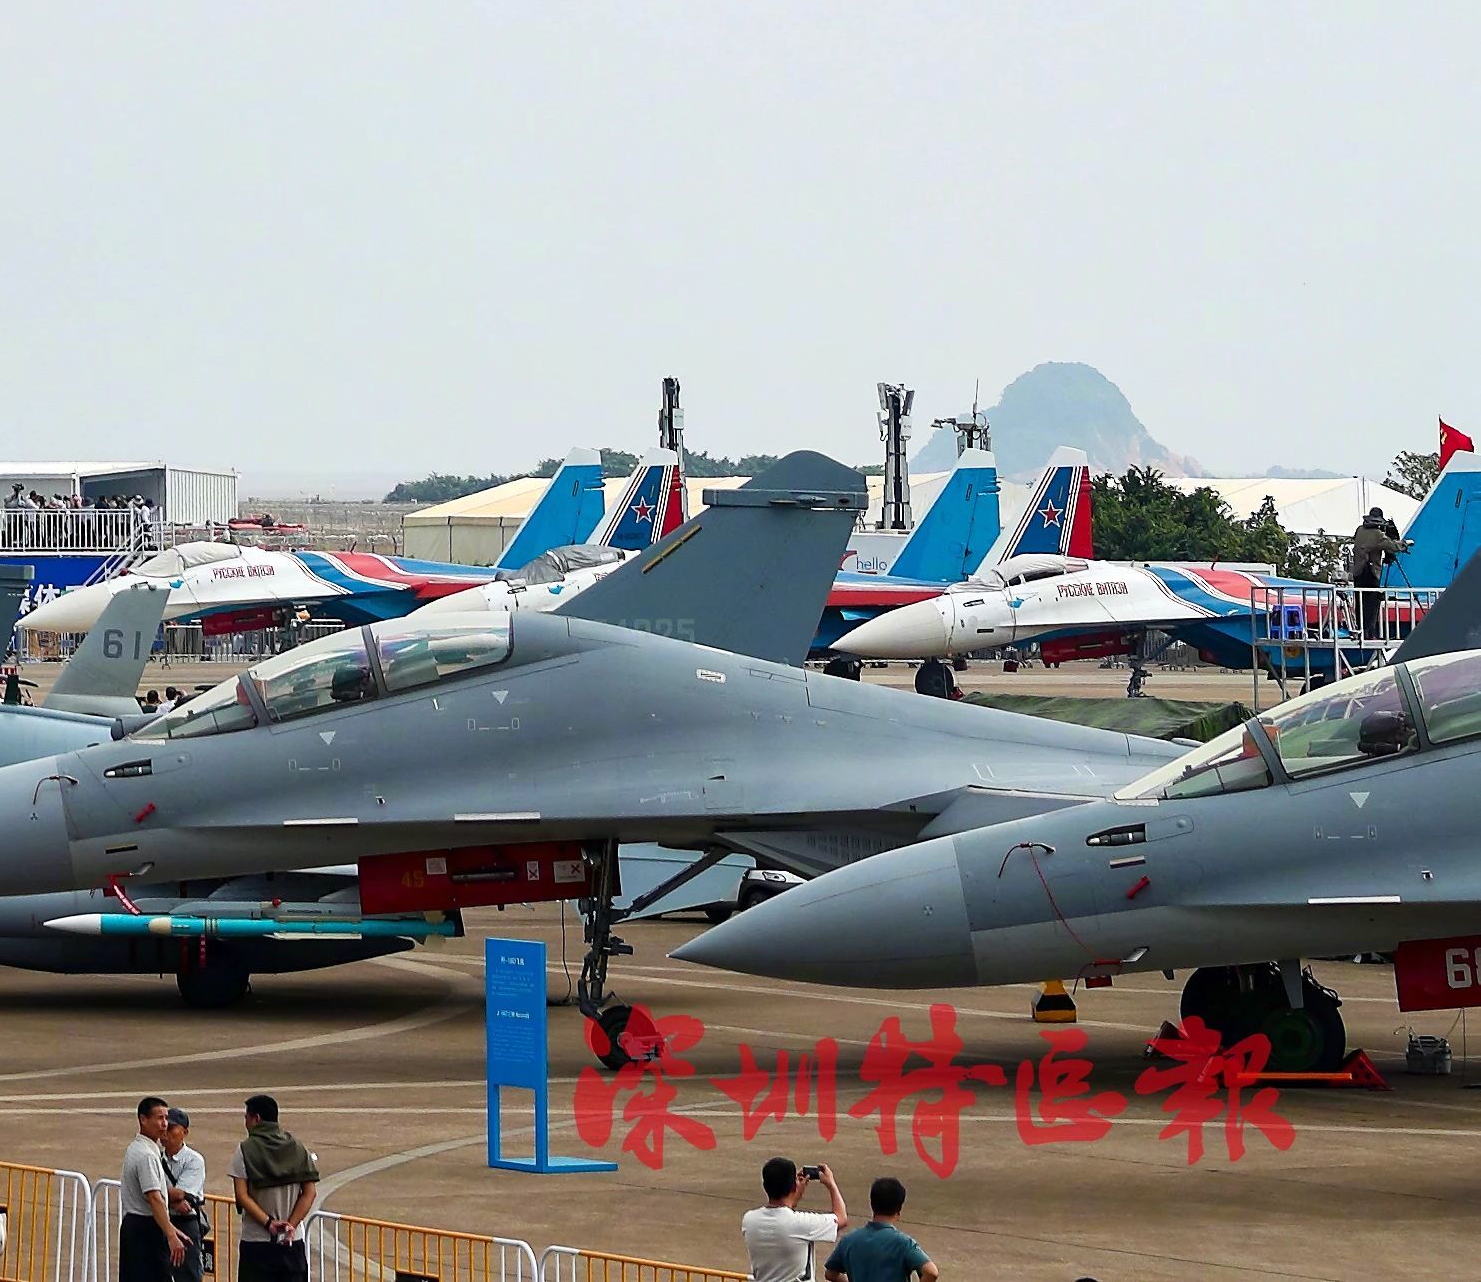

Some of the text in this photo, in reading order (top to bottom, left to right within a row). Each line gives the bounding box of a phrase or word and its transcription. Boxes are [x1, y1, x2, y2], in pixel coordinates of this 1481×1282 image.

[856, 556, 888, 571] hello
[103, 628, 141, 660] 61
[1445, 947, 1481, 990] 6
